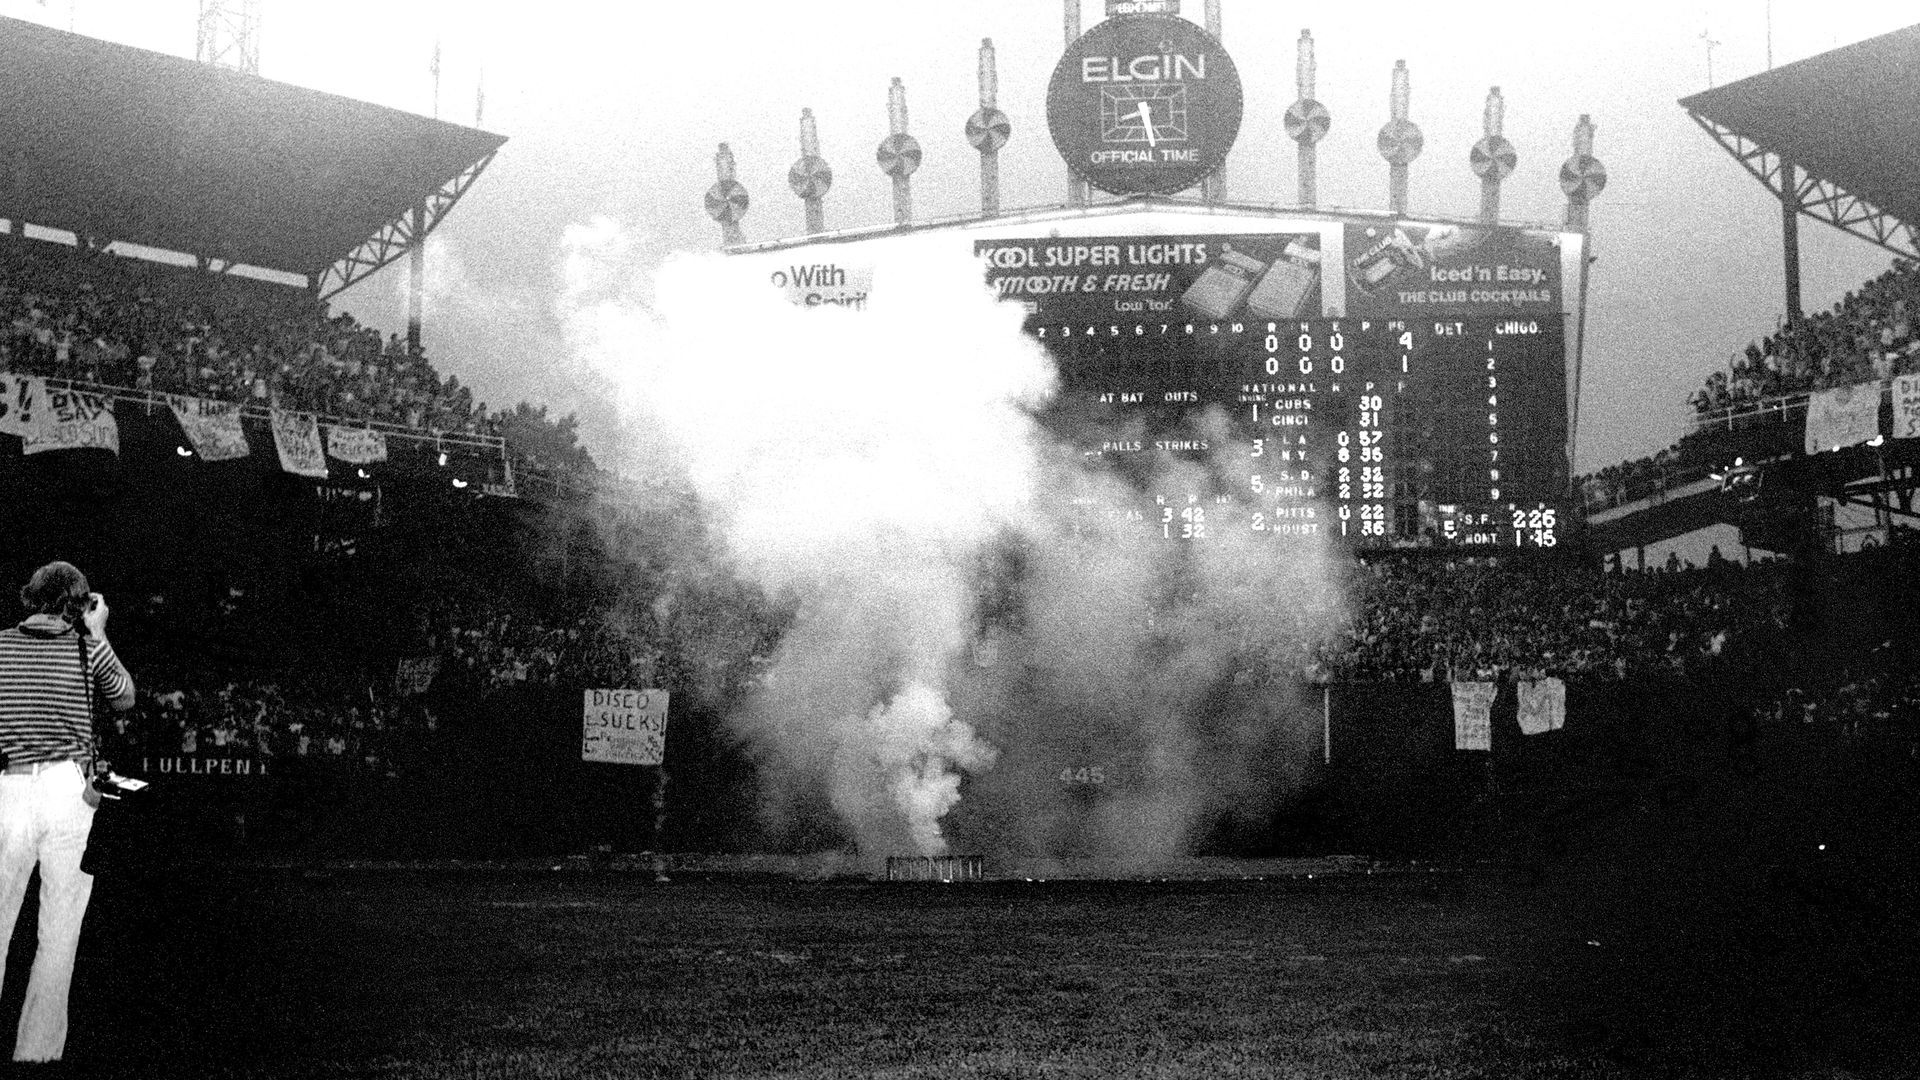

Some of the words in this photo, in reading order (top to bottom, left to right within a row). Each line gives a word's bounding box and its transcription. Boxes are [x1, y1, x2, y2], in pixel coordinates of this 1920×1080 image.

[1082, 54, 1205, 82] ELGIN
[1091, 150, 1156, 164] OFFICIAL
[1162, 149, 1200, 162] TIME
[979, 246, 1039, 268] KOOL
[1045, 245, 1121, 267] SUPER
[1128, 243, 1207, 265] LIGHTS
[790, 263, 846, 287] With
[1496, 264, 1547, 285] Easy.
[993, 275, 1079, 294] SMOOTH
[1082, 274, 1098, 292] &
[1104, 274, 1171, 292] FRESH
[1400, 291, 1427, 303] THE
[1429, 290, 1467, 303] CLUB
[1471, 290, 1551, 303] COCKTAILS
[1114, 299, 1143, 312] Low
[1038, 328, 1046, 338] 2
[1062, 327, 1070, 337] 3
[1086, 326, 1095, 336] 4
[1110, 326, 1119, 335] 5
[1135, 325, 1144, 335] 6
[1161, 325, 1168, 334] 7
[1185, 324, 1194, 334] 8
[1210, 324, 1218, 334] 9
[1232, 323, 1244, 333] 10
[1265, 334, 1279, 352] 0
[1298, 333, 1312, 352] 0
[1330, 332, 1344, 351] 0
[1399, 331, 1413, 350] 4
[1265, 356, 1279, 375] 0
[1330, 356, 1345, 374] 0
[1402, 354, 1408, 373] 1
[1487, 358, 1495, 370] 2
[1242, 382, 1317, 393] NATIONAL
[1488, 376, 1497, 388] 3
[1099, 392, 1115, 403] AT
[1121, 392, 1144, 403] BAT
[1164, 391, 1199, 402] OUTS
[1274, 399, 1312, 410] CUBS
[1359, 395, 1382, 411] 30
[1488, 395, 1497, 406] 4
[1271, 415, 1309, 425] CINCI
[1359, 411, 1379, 427] 31
[1488, 413, 1497, 425] 5
[1155, 440, 1209, 451] STRIKES
[1298, 434, 1306, 445] A
[1338, 430, 1350, 446] 0
[1489, 432, 1498, 444] 6
[1250, 439, 1263, 457] 3
[1490, 450, 1498, 461] 7
[1360, 466, 1384, 482] 32
[1490, 469, 1499, 481] 8
[1250, 474, 1264, 494] 5
[1275, 486, 1315, 497] PHILA
[1491, 488, 1500, 500] 9
[1161, 507, 1173, 523] 3
[1180, 507, 1205, 523] 42
[1275, 506, 1315, 518] PITTS
[1360, 504, 1384, 520] 22
[1513, 509, 1526, 528] 2
[1528, 509, 1556, 528] 26
[1251, 512, 1265, 531] 2
[1272, 523, 1318, 534] HOUST
[1341, 520, 1347, 536] 1
[1163, 524, 1169, 538] 1
[1181, 523, 1206, 538] 32
[1465, 533, 1497, 544] MONT
[1516, 529, 1521, 547] 1
[593, 690, 650, 710] DISCO
